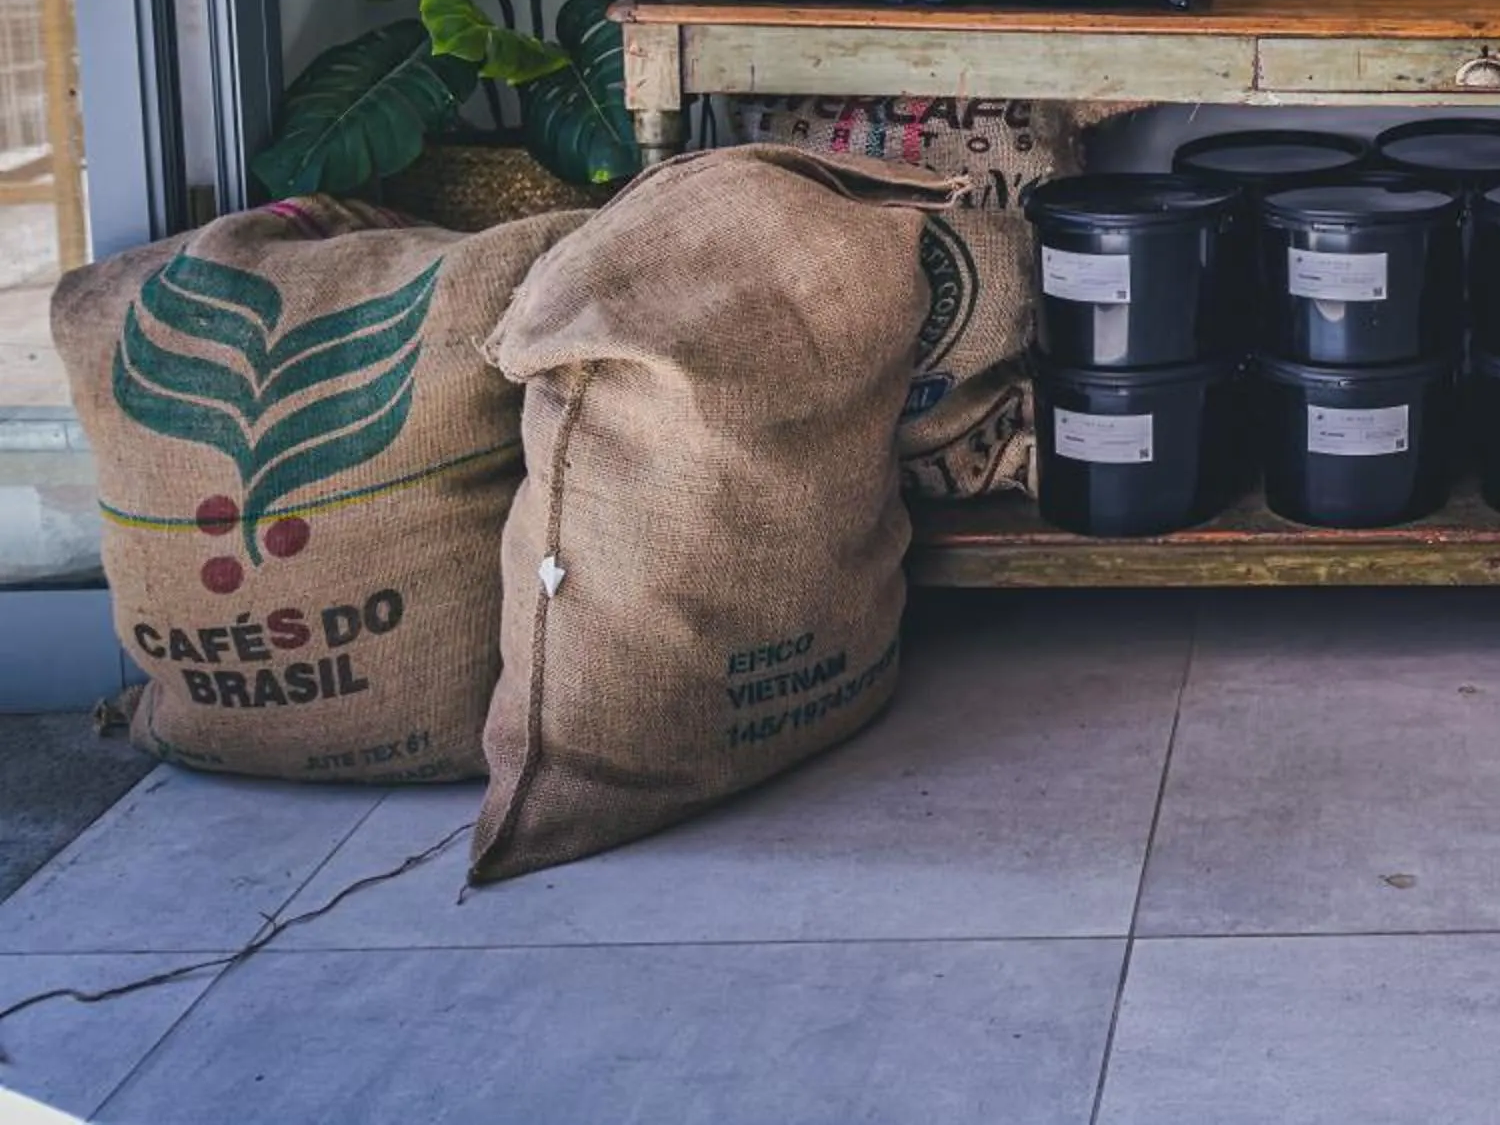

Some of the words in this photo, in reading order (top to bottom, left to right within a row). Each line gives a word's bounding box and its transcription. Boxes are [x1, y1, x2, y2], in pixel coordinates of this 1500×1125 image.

[134, 607, 311, 664] CAFÉS
[321, 588, 404, 648] DO
[181, 653, 369, 708] BRASIL
[726, 650, 847, 709] VIETNAM
